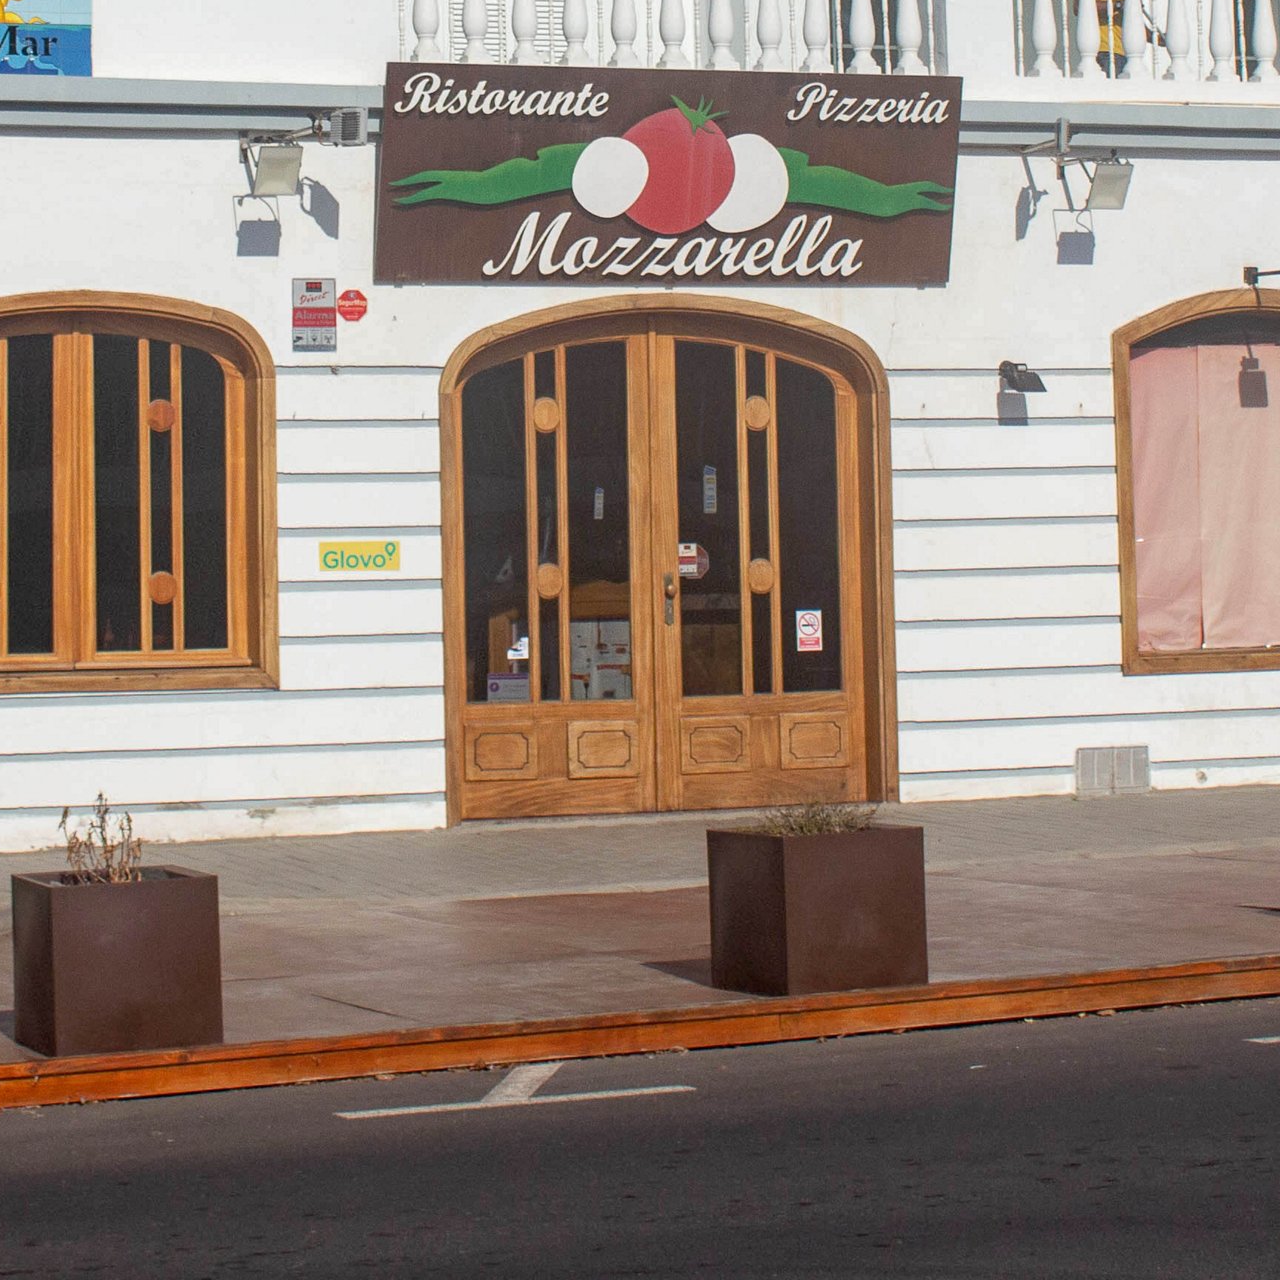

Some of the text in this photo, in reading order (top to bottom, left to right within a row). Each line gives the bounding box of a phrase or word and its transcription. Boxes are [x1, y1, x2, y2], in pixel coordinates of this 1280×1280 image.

[394, 72, 610, 118] Ristorante
[786, 82, 949, 125] Pizzeria
[482, 211, 863, 278] Mozzarella
[323, 550, 386, 569] Glovo
